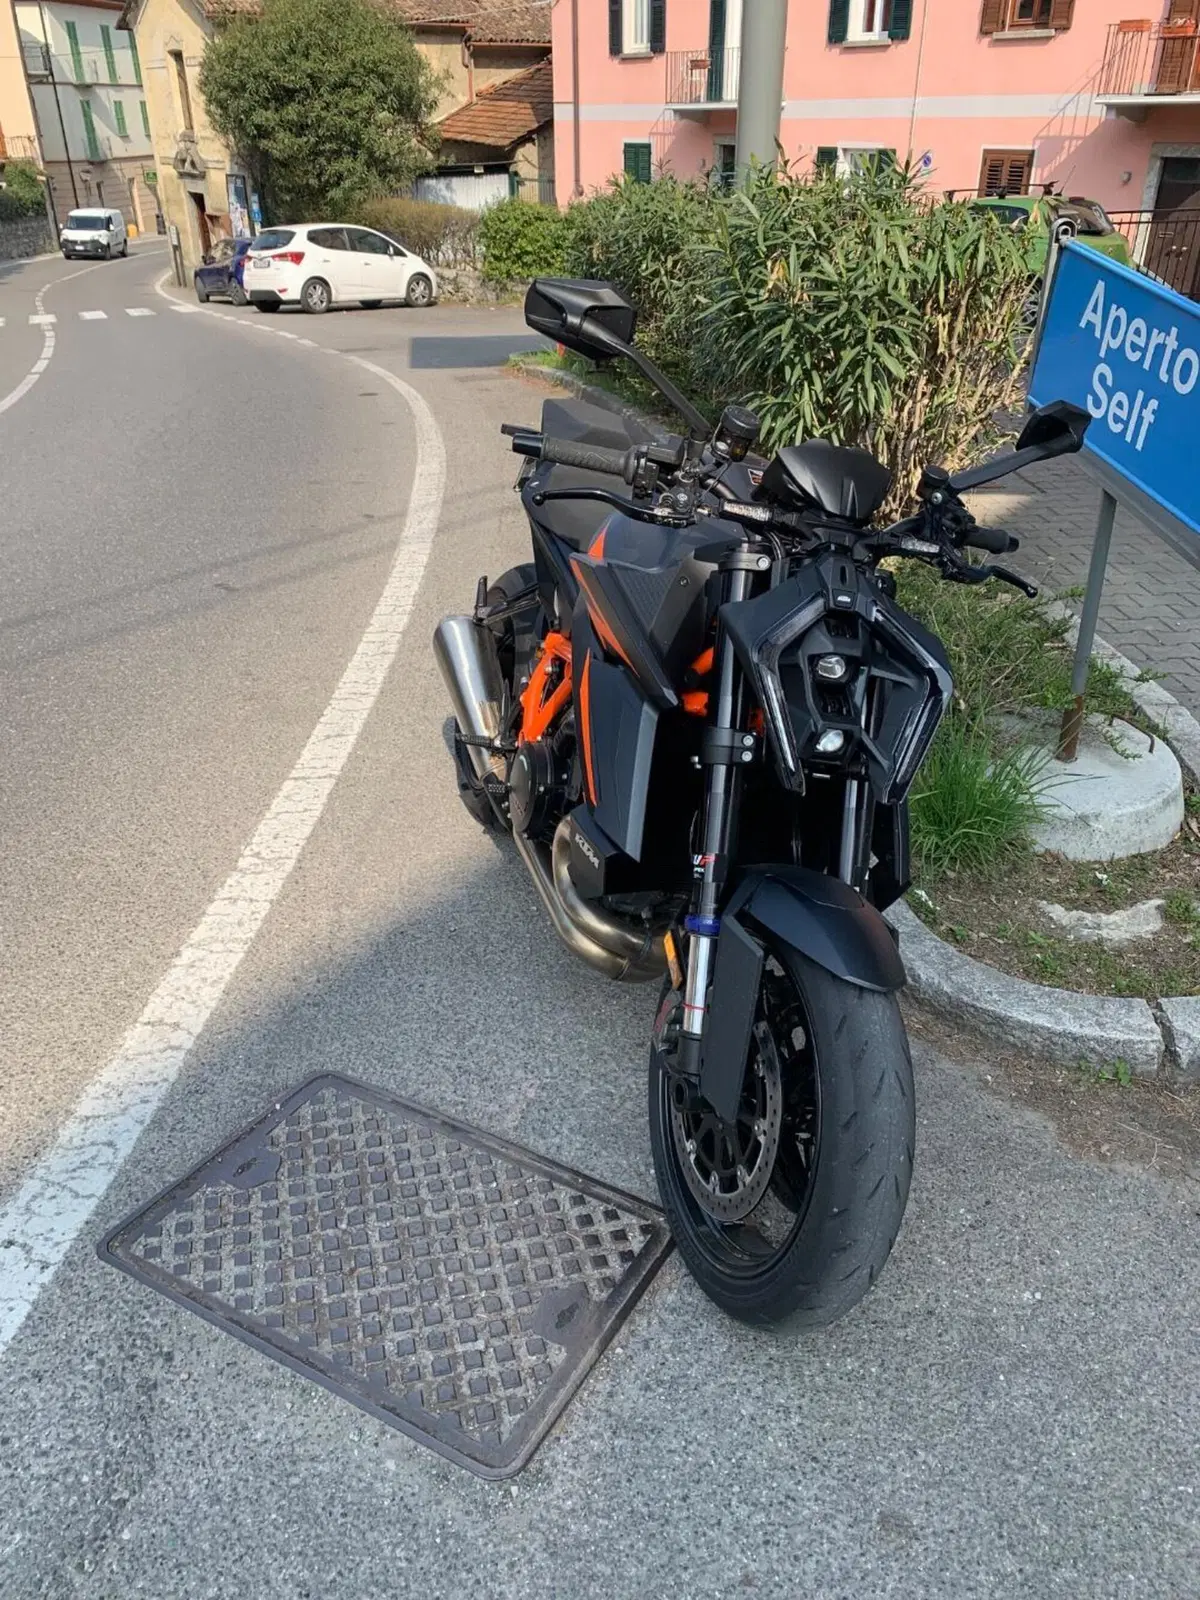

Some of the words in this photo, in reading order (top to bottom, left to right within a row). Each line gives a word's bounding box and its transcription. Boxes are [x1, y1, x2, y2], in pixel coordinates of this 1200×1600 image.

[1079, 280, 1199, 394] Aperto
[1087, 363, 1158, 451] Self
[575, 833, 600, 869] KTM
